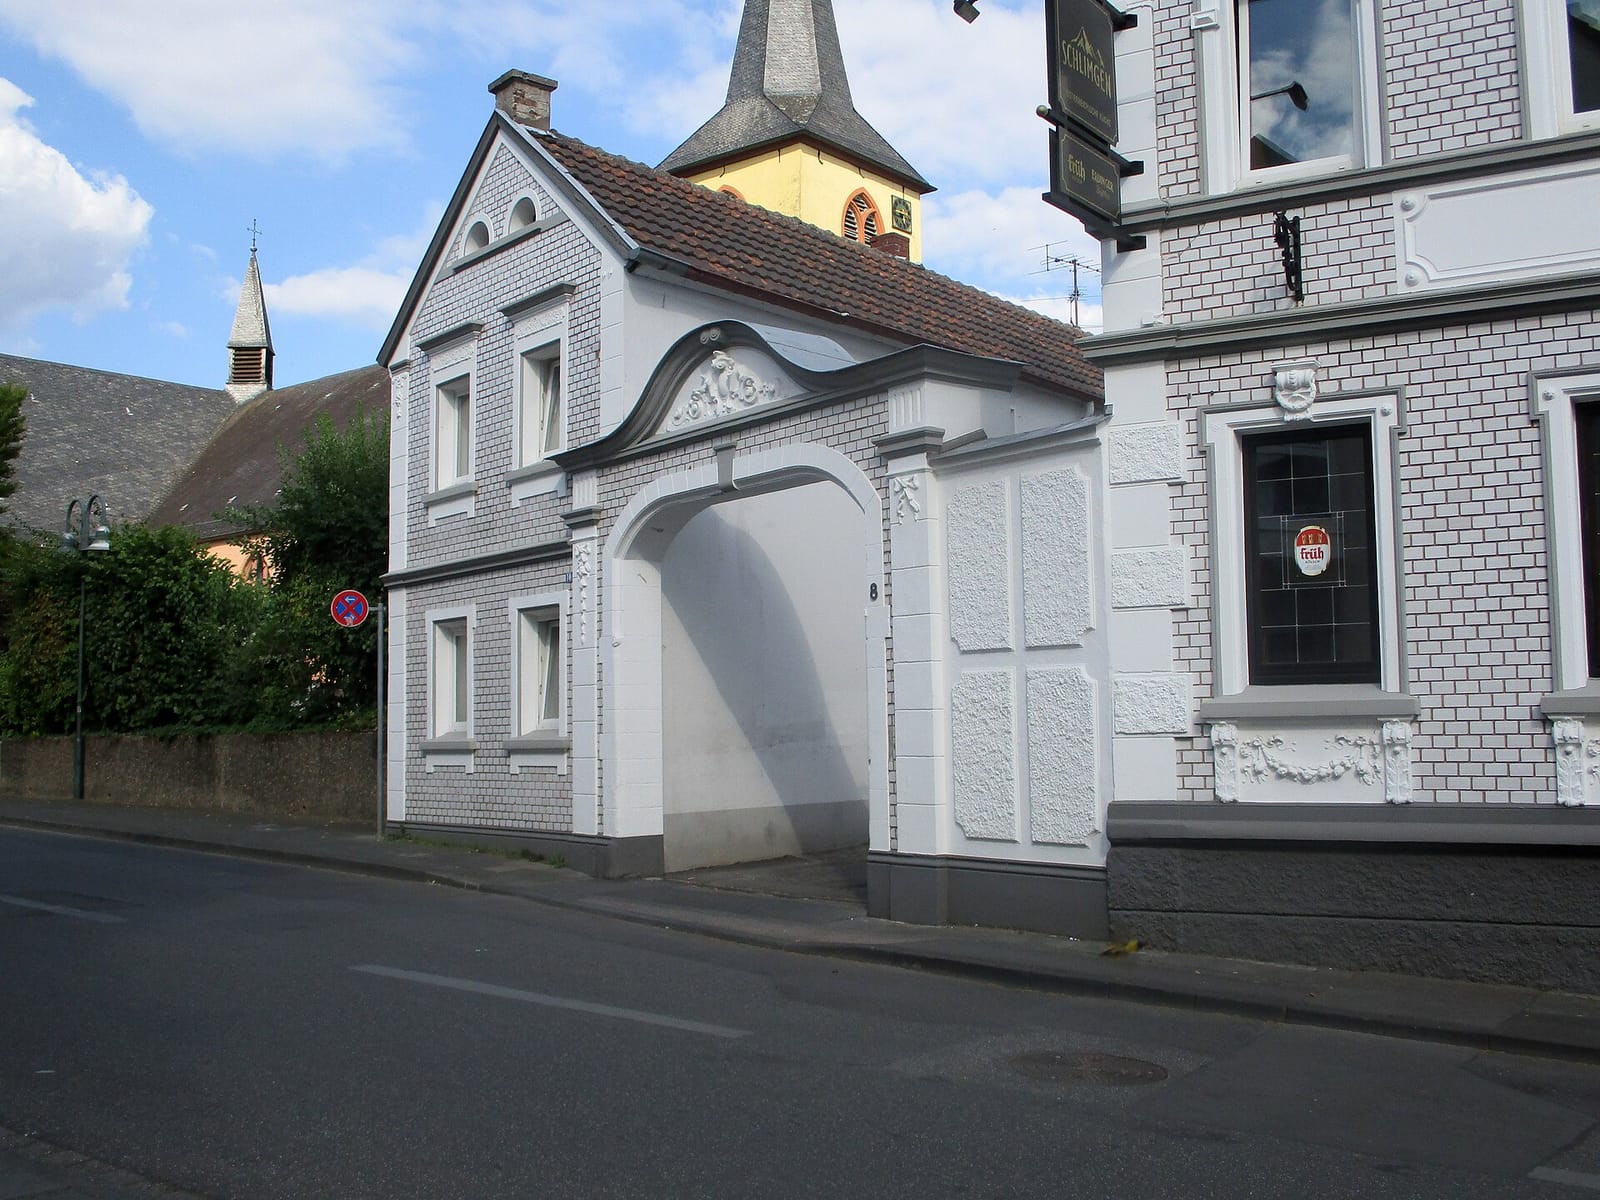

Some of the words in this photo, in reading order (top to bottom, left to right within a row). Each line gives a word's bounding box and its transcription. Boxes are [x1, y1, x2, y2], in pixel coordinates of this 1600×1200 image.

[1062, 40, 1111, 99] SCHLIMGEN
[1300, 547, 1324, 560] früh
[870, 583, 878, 601] 8
